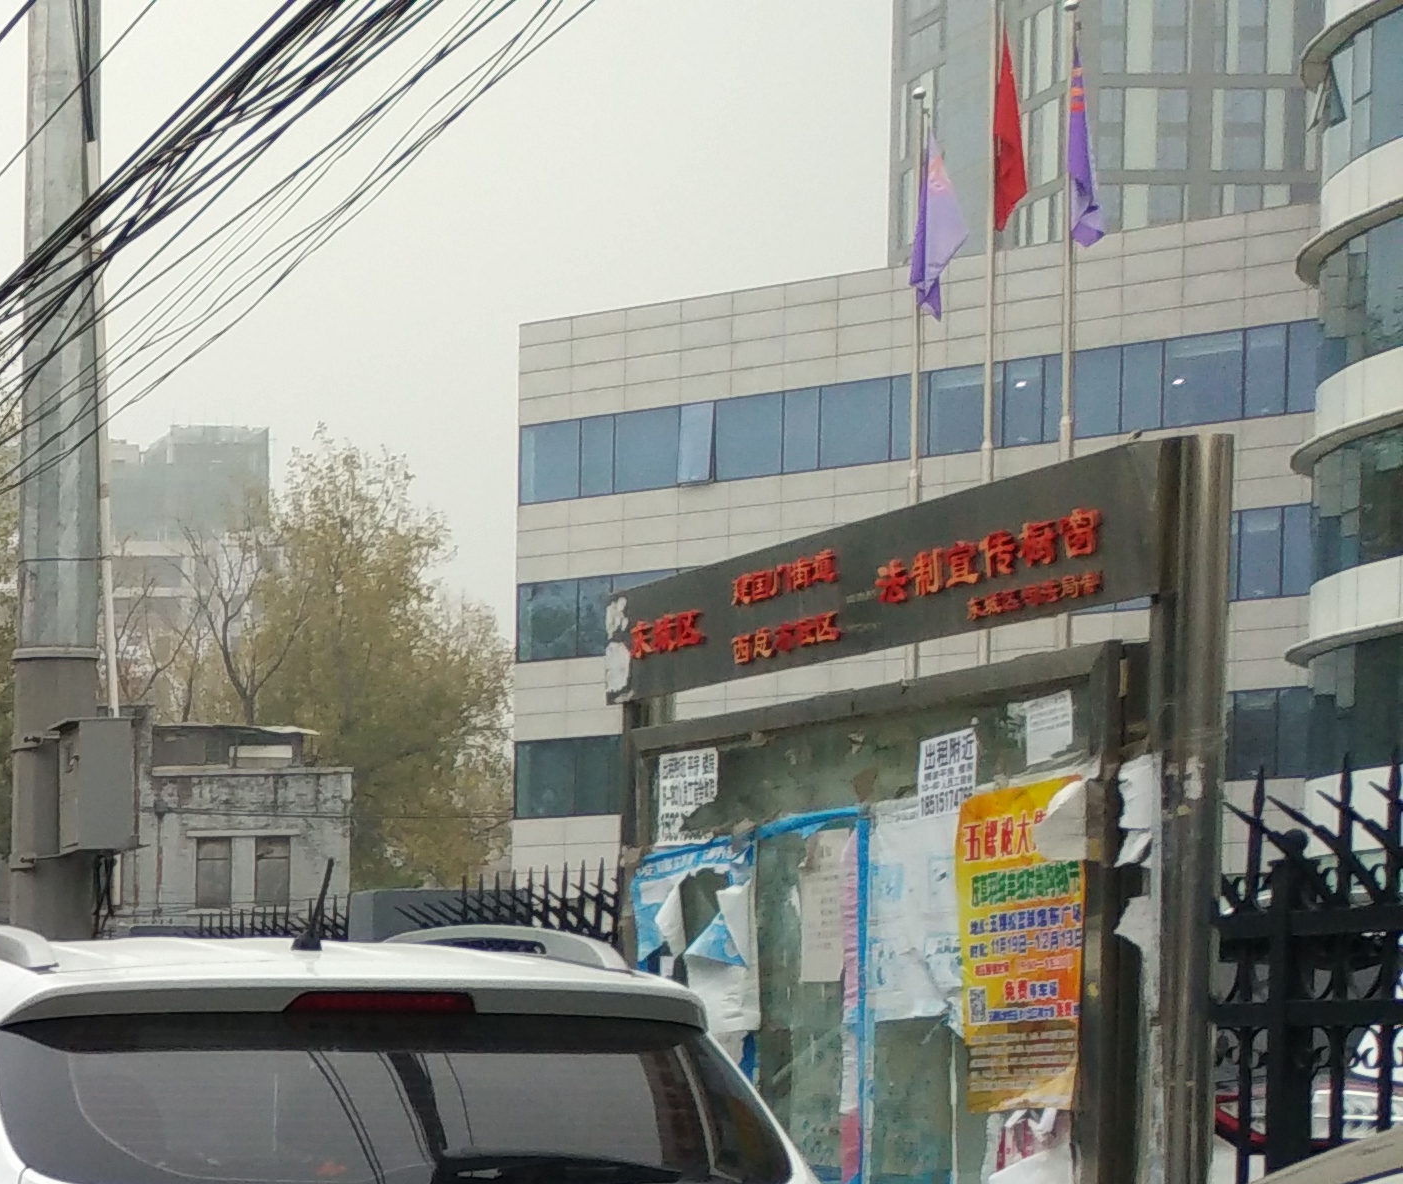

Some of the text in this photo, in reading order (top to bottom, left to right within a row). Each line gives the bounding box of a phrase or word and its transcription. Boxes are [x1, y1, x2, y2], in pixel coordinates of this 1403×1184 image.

[731, 549, 839, 607] 建国门街道
[875, 507, 1100, 604] 法制宣传橱窗
[630, 609, 706, 659] 东城区
[924, 733, 975, 771] 出租附近
